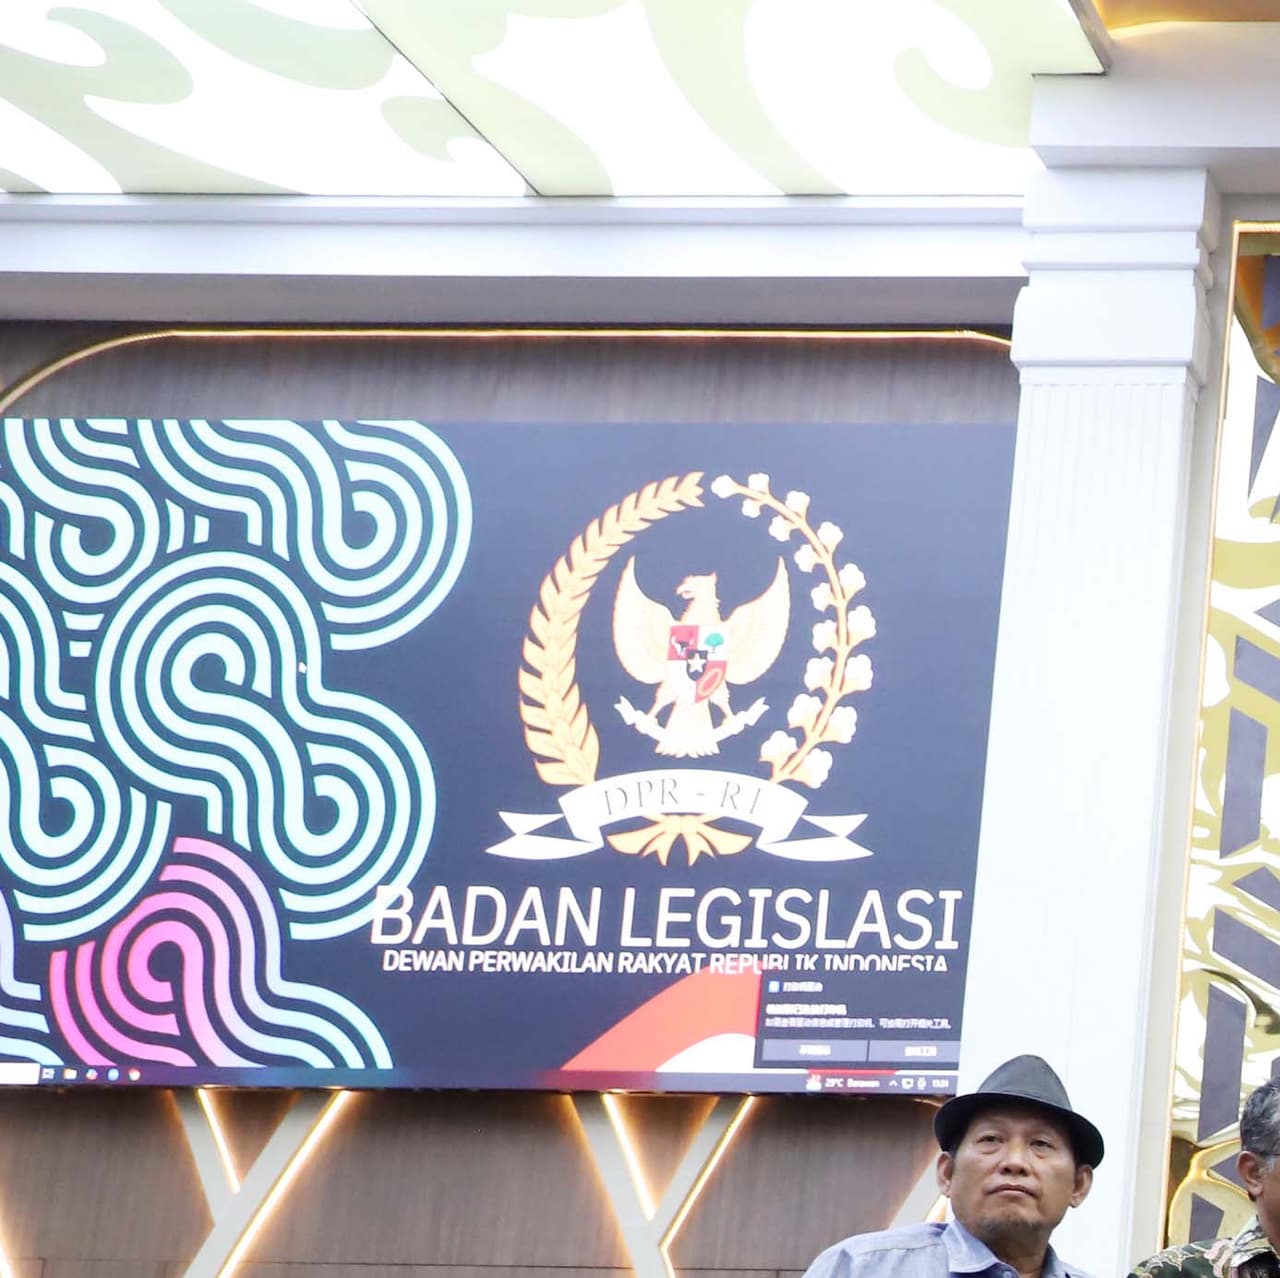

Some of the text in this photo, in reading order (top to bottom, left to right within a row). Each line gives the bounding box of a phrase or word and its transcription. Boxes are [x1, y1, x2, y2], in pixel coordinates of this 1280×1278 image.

[604, 777, 679, 816] DPR
[720, 780, 762, 815] RI
[370, 885, 963, 950] BADAN LEGISLASI
[383, 950, 464, 972] DEWAN
[468, 951, 613, 974] PERWAKILAN
[617, 952, 706, 975] RAKYAT
